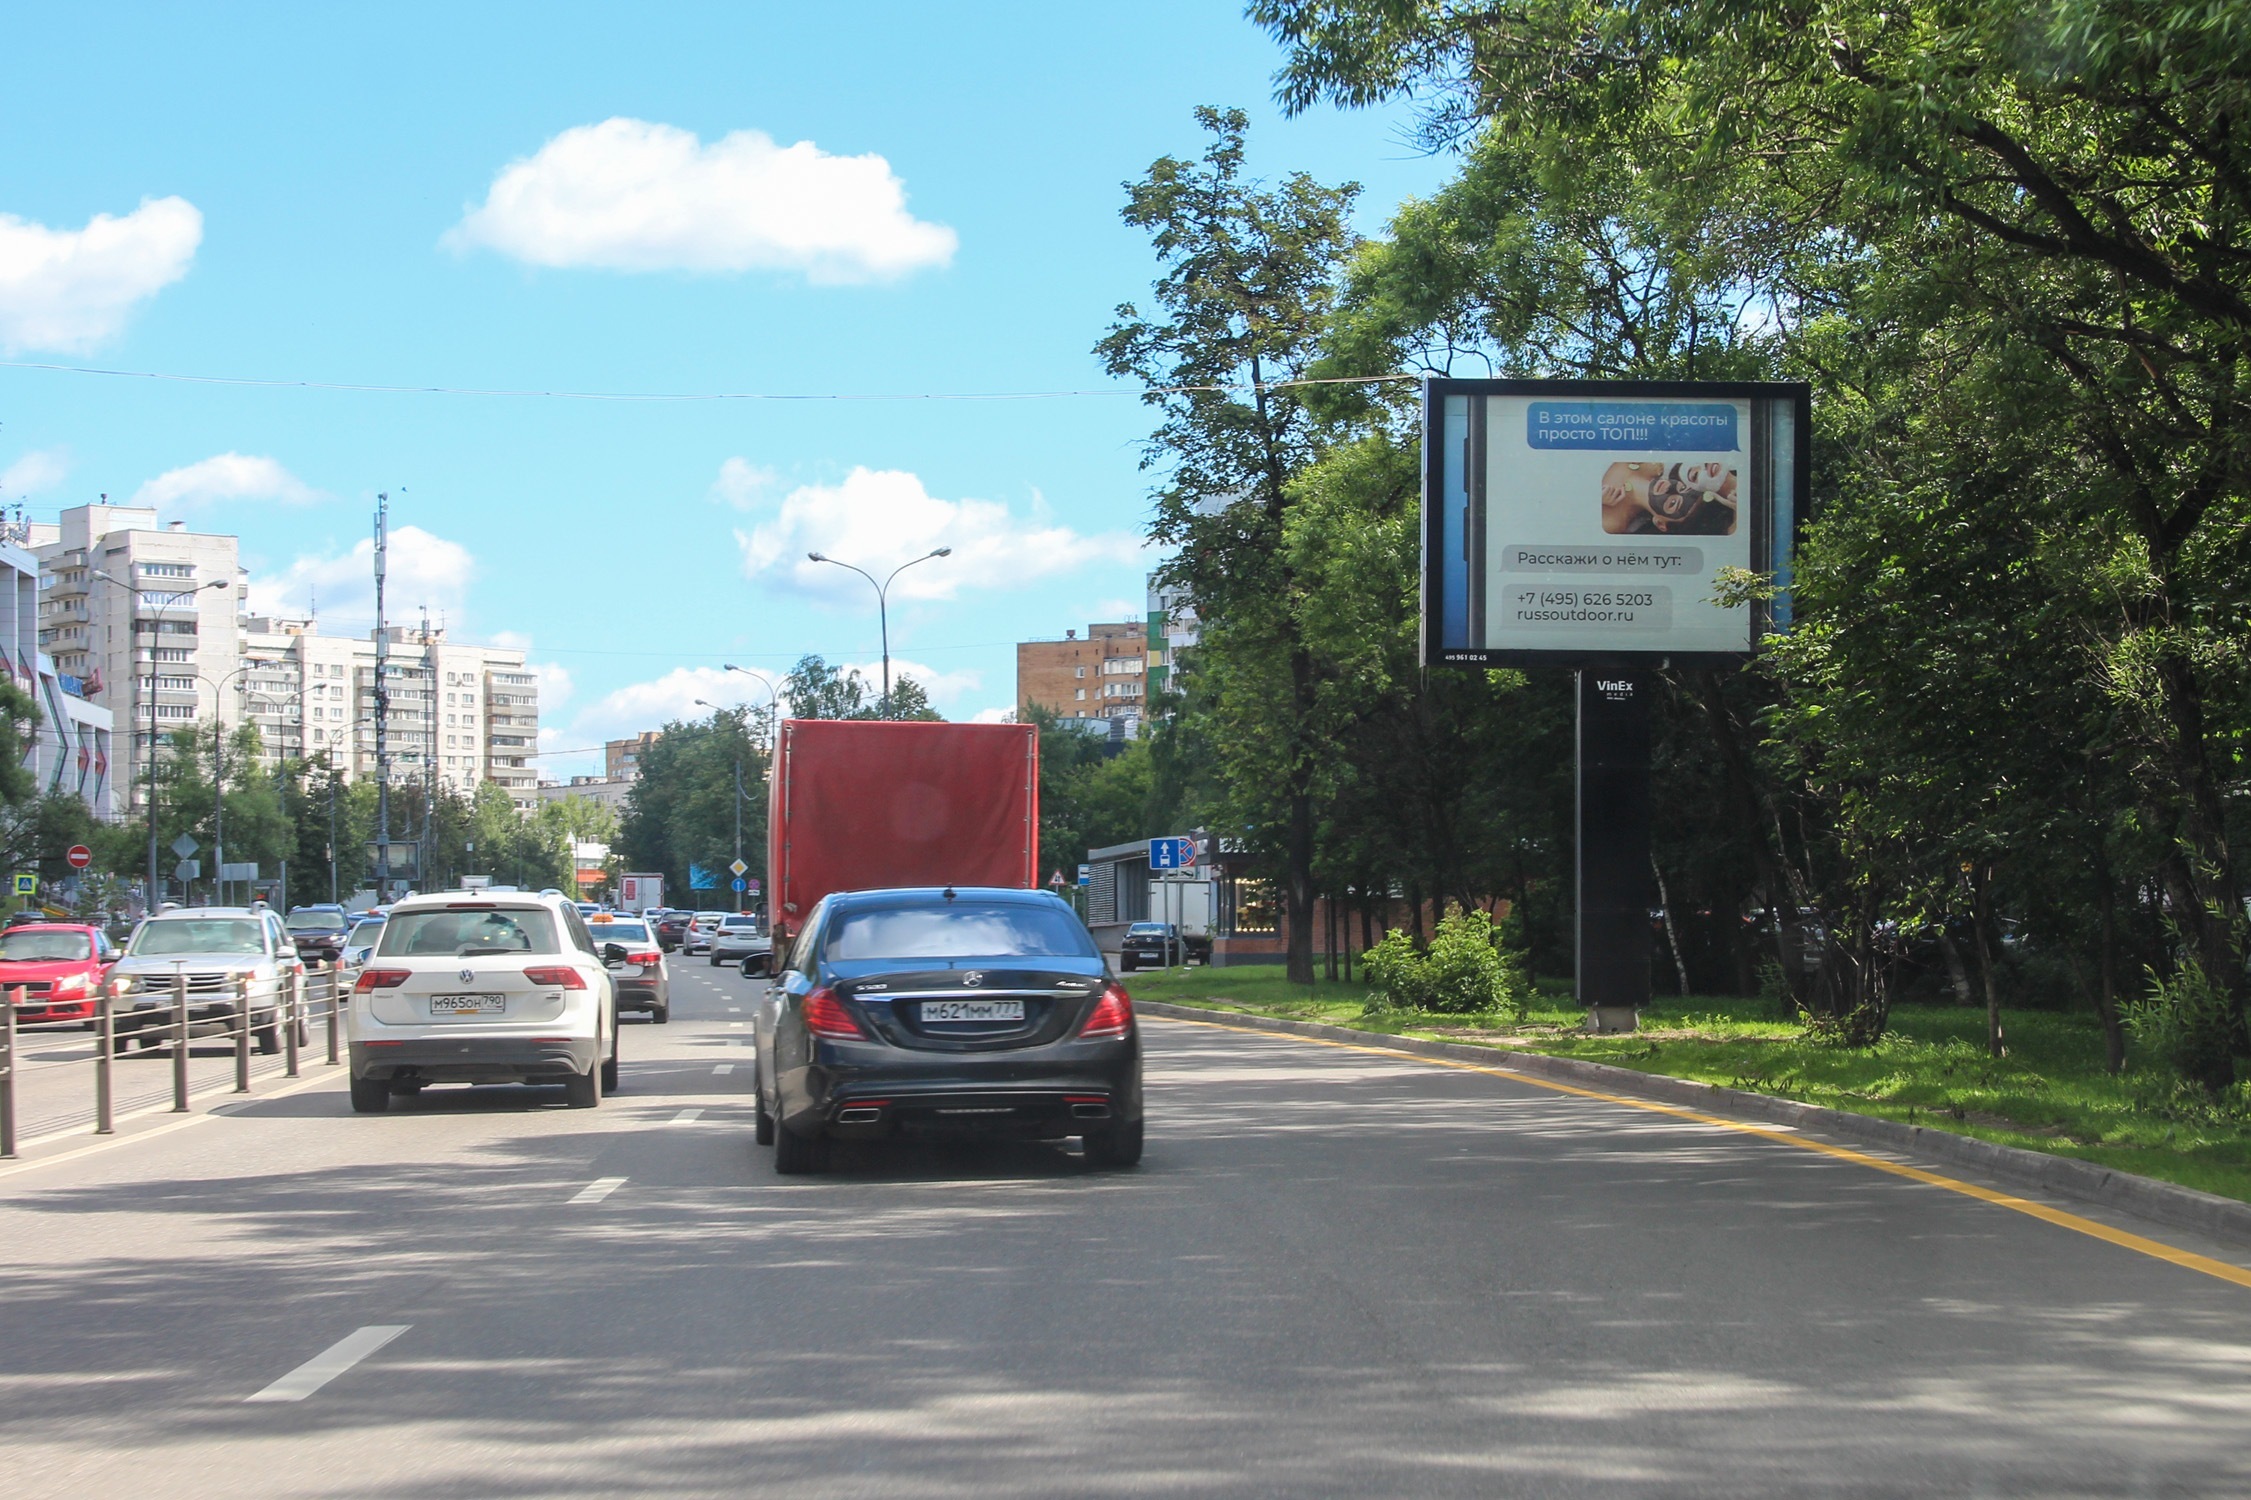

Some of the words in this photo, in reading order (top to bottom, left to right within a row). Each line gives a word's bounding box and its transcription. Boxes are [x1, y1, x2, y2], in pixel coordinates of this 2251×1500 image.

[1539, 411, 1550, 424] В
[1554, 413, 1593, 424] этом
[1597, 414, 1656, 425] салоне
[1660, 414, 1728, 428] красоты
[1538, 429, 1596, 442] просто
[1600, 427, 1648, 441] ТОП!!!
[1518, 552, 1597, 565] Расскажи
[1602, 555, 1612, 566] о
[1617, 553, 1649, 566] нём
[1653, 555, 1682, 569] тут:
[1517, 592, 1535, 605] +7
[1540, 592, 1578, 607] (495)
[1583, 593, 1612, 606] 626
[1616, 593, 1653, 606] 5203
[1517, 609, 1634, 622] russoutdoor.ru
[1596, 680, 1633, 691] VinEx
